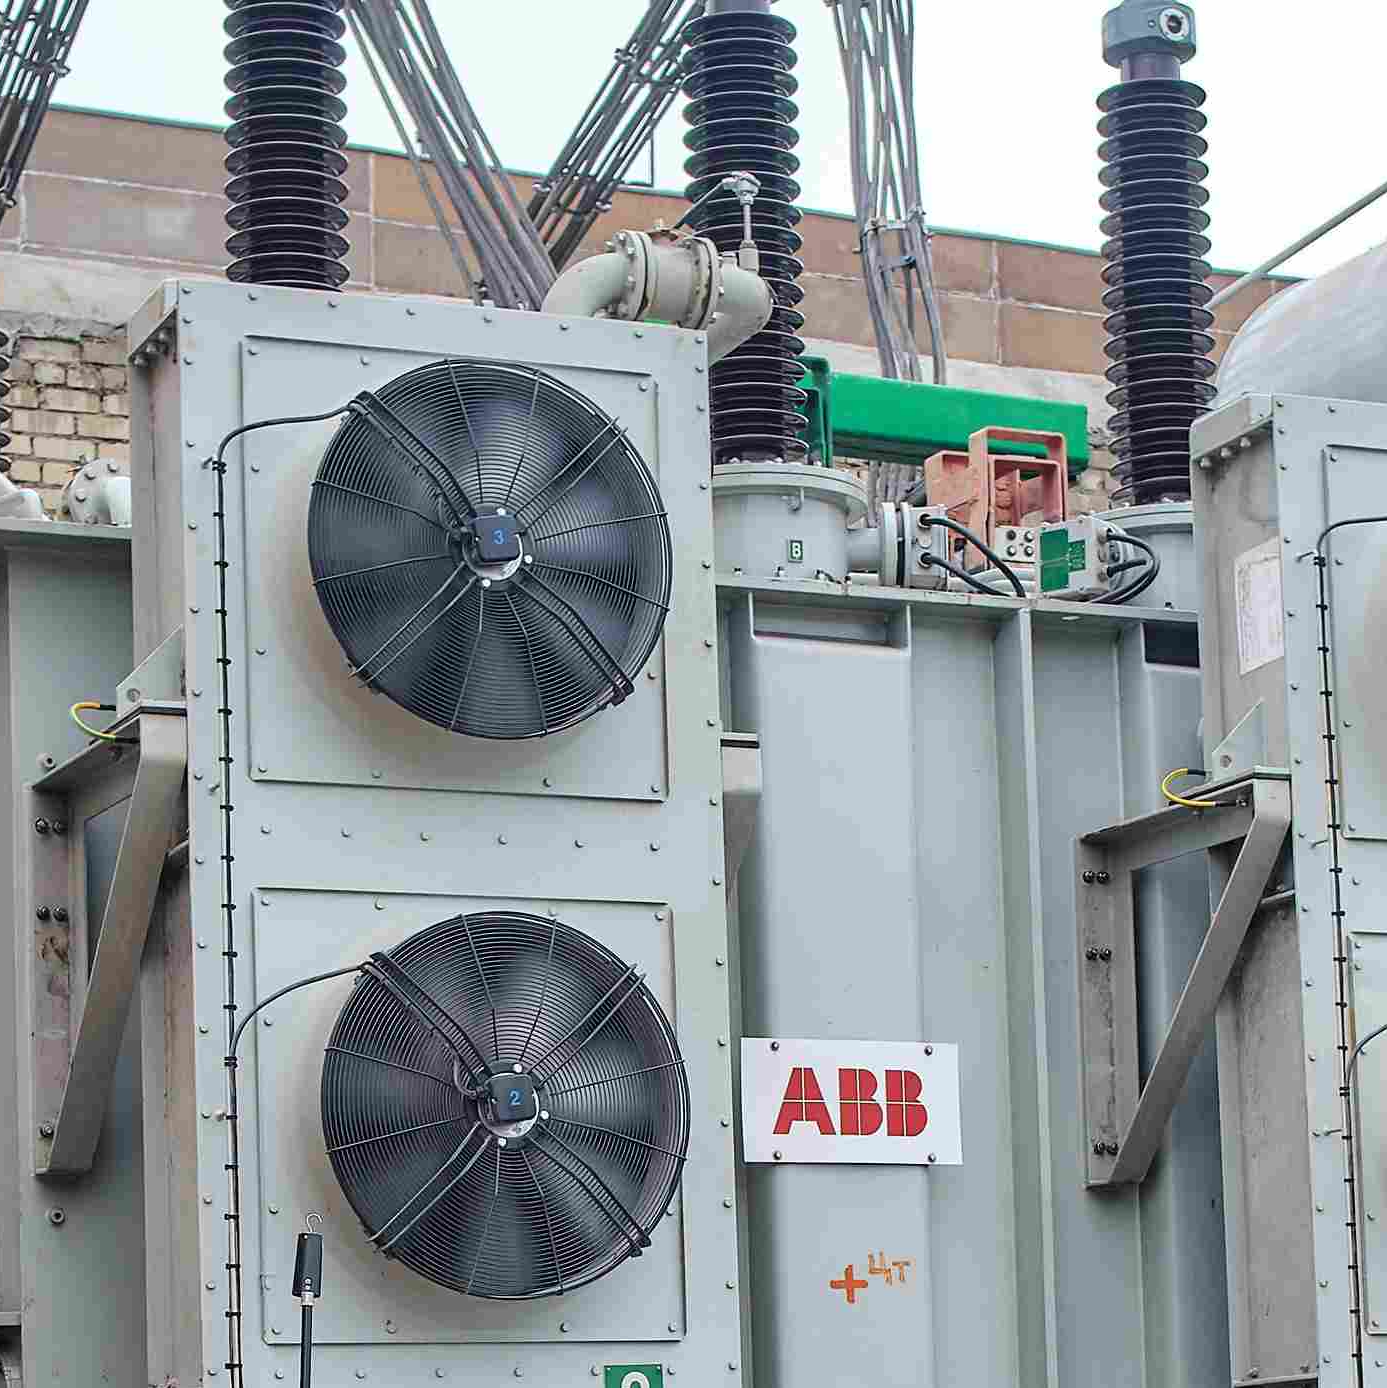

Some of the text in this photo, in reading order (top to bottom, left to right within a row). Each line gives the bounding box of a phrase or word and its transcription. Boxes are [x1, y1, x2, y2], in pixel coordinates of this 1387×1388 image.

[493, 529, 504, 545] 3
[510, 1090, 522, 1105] 2
[772, 1066, 928, 1137] ABB
